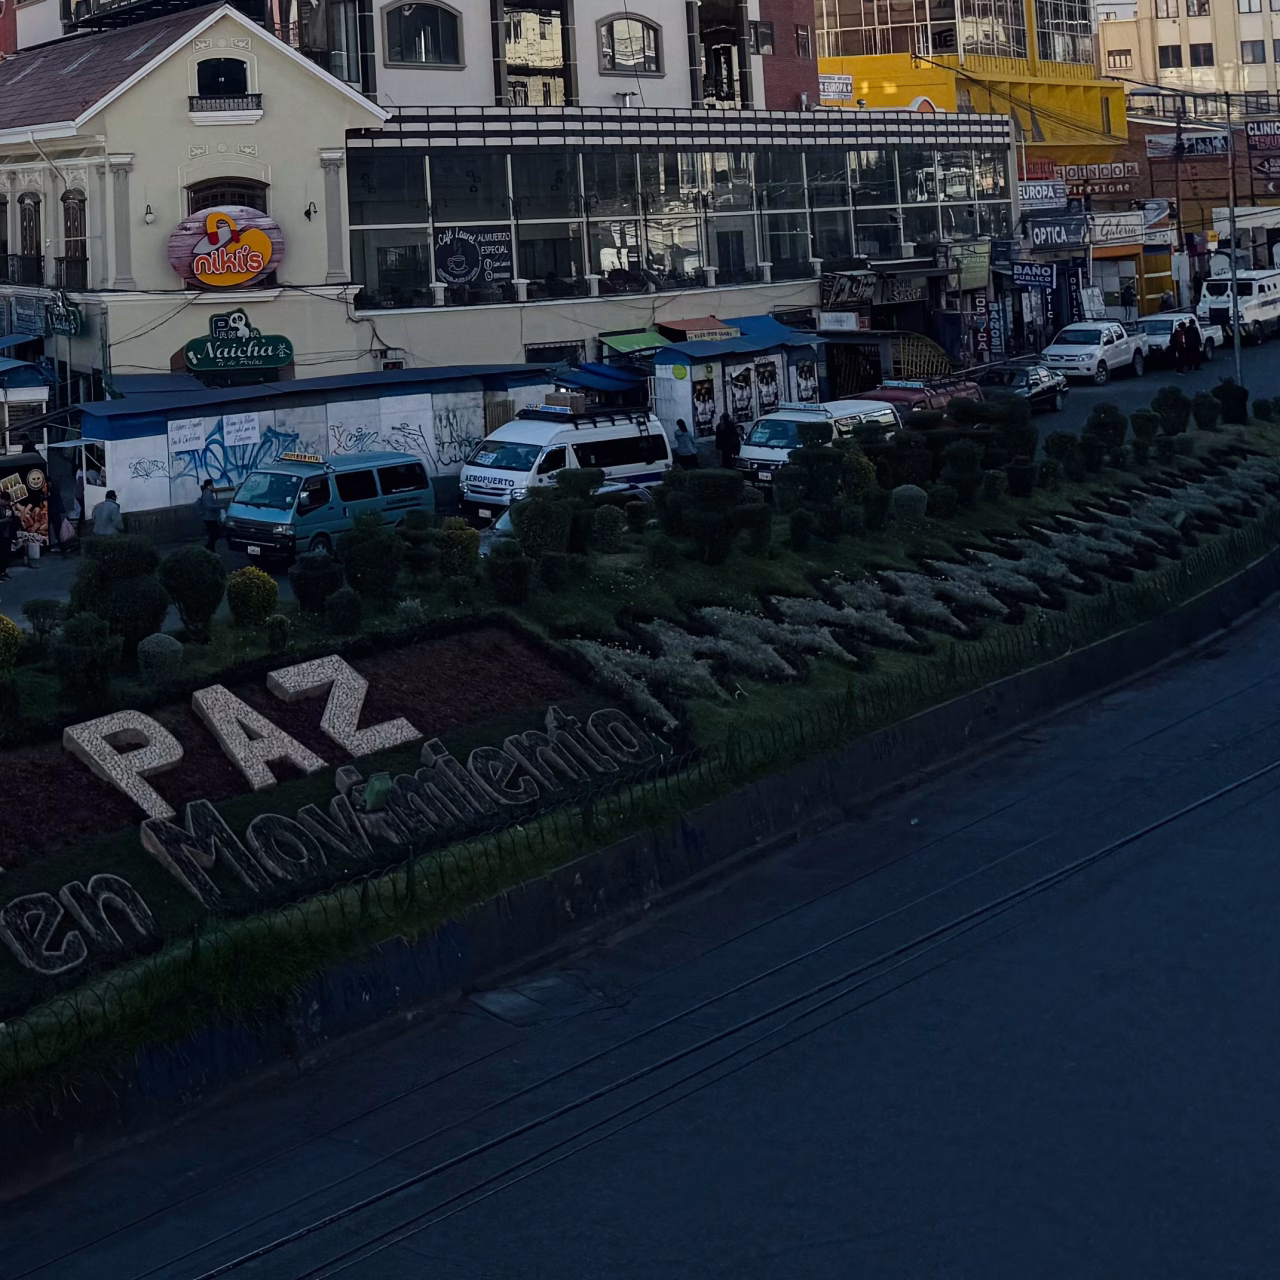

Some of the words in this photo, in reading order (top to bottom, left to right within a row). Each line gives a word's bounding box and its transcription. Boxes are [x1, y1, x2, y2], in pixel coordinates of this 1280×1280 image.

[1019, 185, 1055, 200] EUROPA
[1065, 183, 1131, 195] Firestone
[476, 232, 511, 242] ALMUERZO
[1033, 226, 1069, 246] OPTICA
[480, 245, 509, 255] ESPECIAL
[193, 245, 264, 274] niki's
[1013, 264, 1052, 276] BAÑO
[213, 316, 261, 339] PANA
[974, 298, 989, 351] OPICA
[465, 474, 515, 488] AEROPUERTO
[62, 653, 424, 819] PAZ
[139, 704, 655, 912] Movimiento
